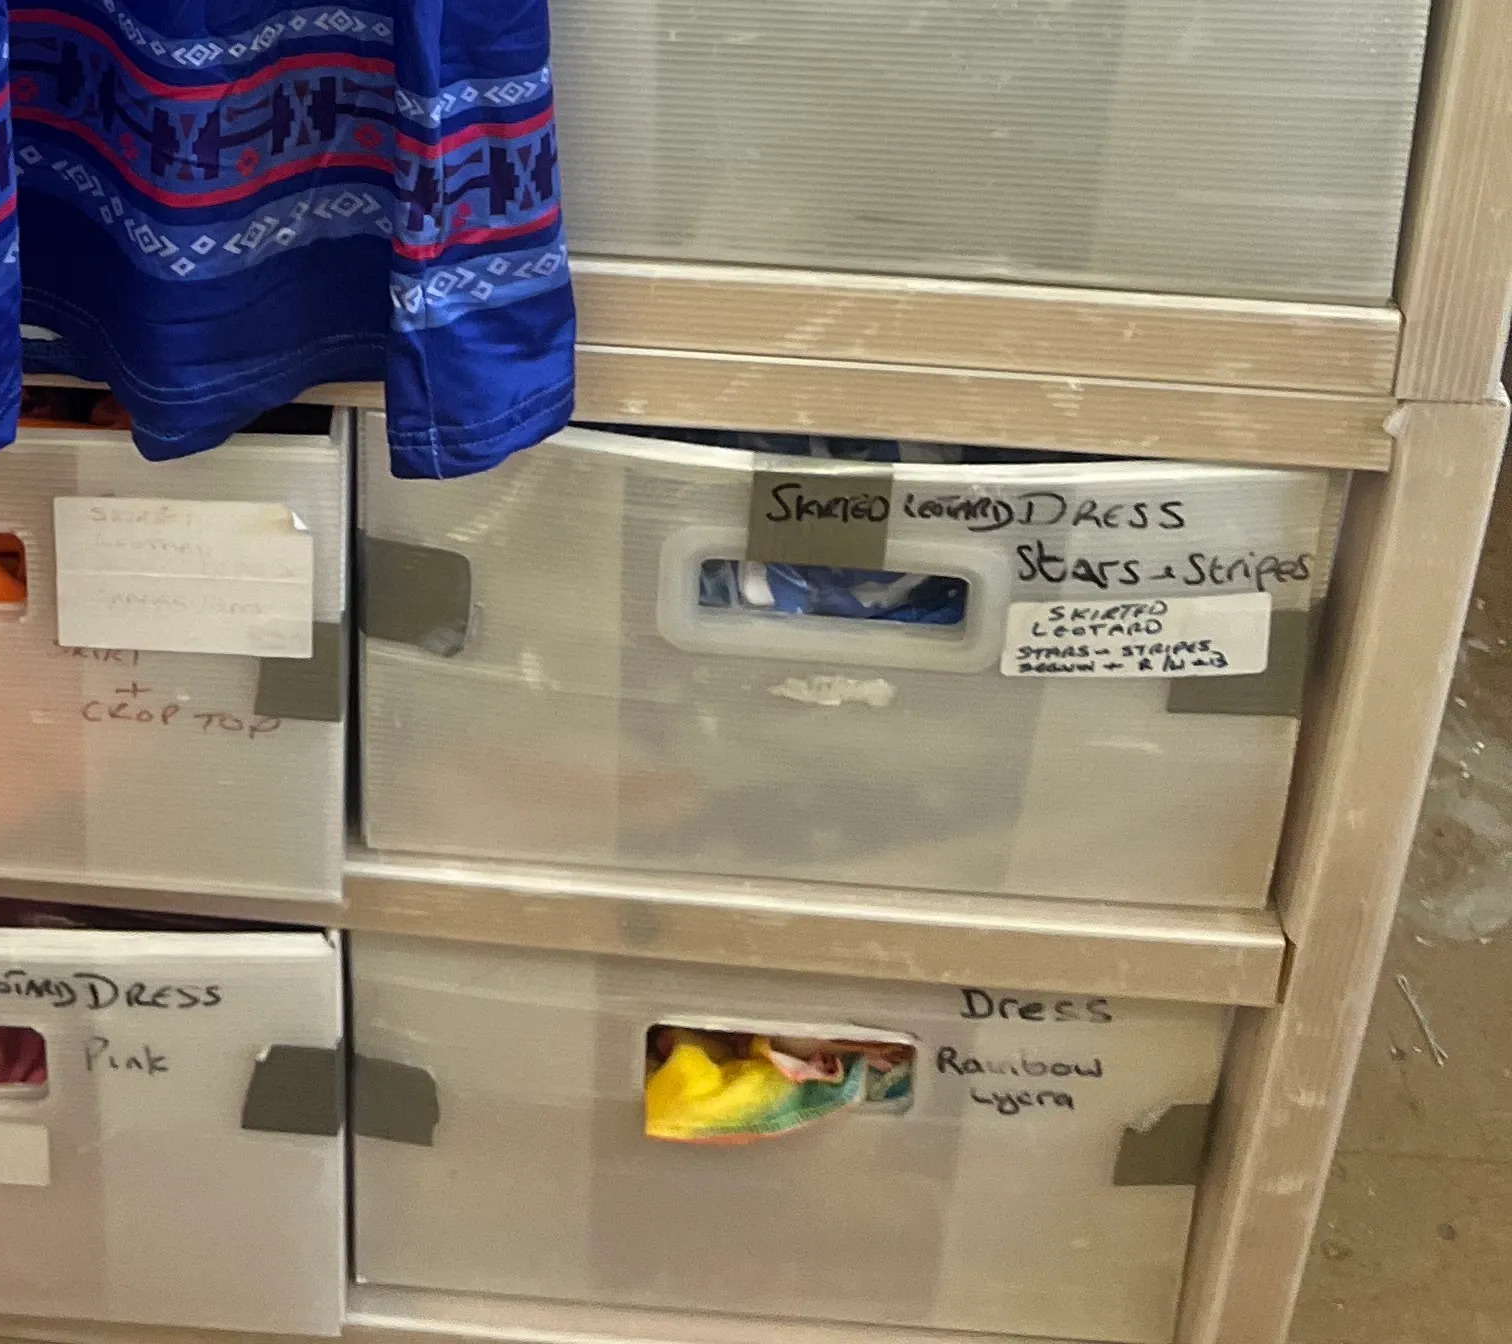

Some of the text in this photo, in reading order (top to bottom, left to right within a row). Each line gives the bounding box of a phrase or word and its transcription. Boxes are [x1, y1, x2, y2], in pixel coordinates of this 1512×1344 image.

[1031, 618, 1163, 636] LEOTARD
[1048, 600, 1168, 621] SKIRTED
[1016, 645, 1090, 660] STARS
[115, 681, 153, 698] +
[81, 700, 281, 740] CROP TOP
[74, 973, 223, 1010] DRESS
[960, 989, 1113, 1023] Dress
[85, 1036, 170, 1074] Pink
[937, 1046, 1103, 1079] Rainbow
